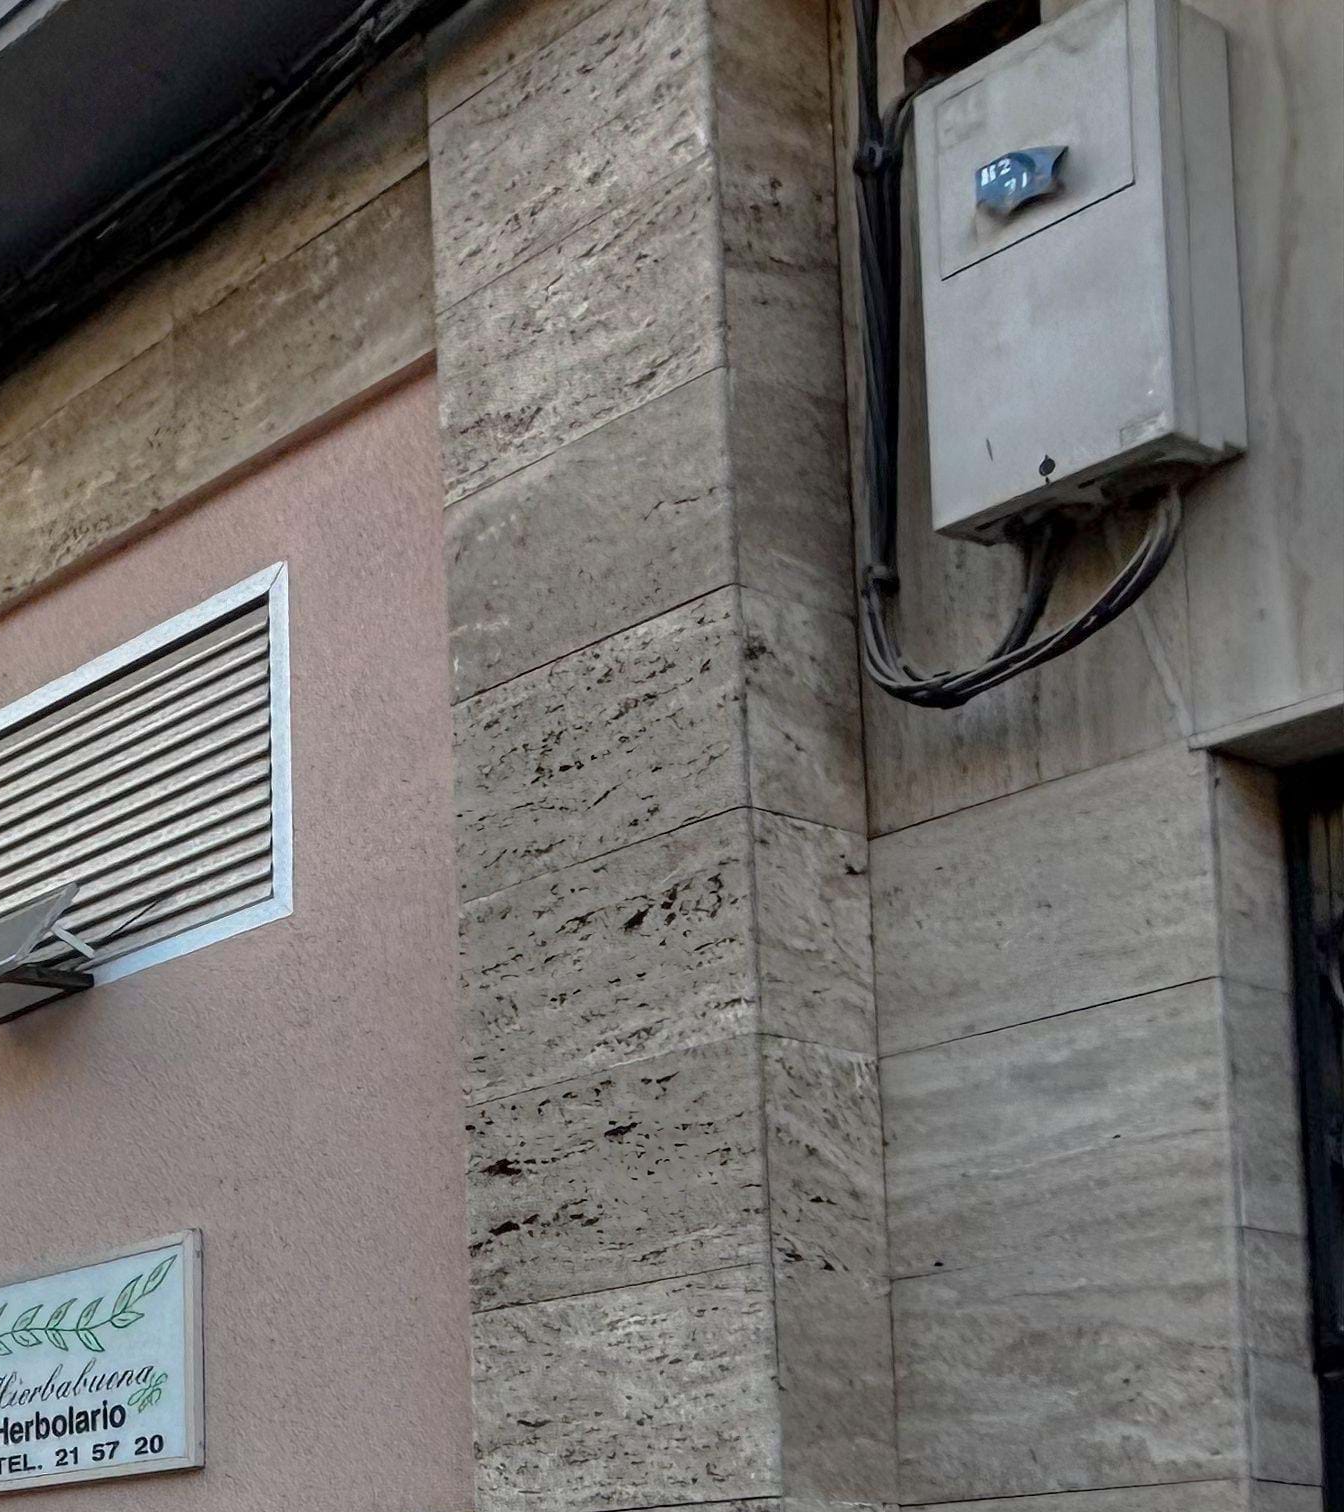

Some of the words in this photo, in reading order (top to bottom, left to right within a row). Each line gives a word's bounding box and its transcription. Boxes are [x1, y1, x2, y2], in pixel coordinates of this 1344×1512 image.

[55, 1447, 79, 1467] 21
[91, 1441, 120, 1463] 57
[134, 1434, 164, 1456] 20
